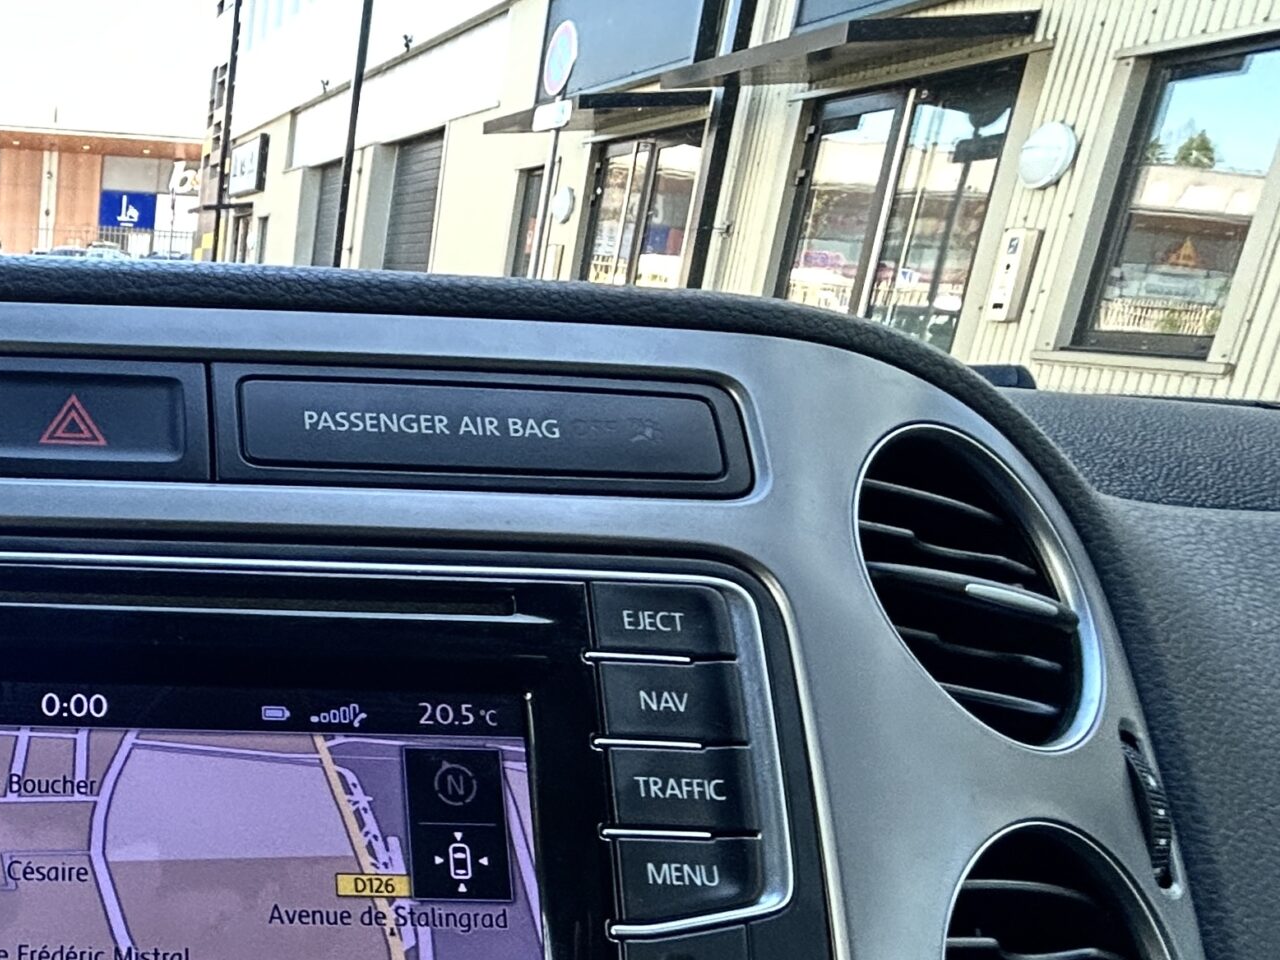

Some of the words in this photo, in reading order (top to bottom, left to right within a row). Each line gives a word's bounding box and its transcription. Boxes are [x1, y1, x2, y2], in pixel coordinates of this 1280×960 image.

[304, 411, 449, 435] PASSENGER
[459, 415, 500, 437] AIR
[508, 417, 561, 438] BAG
[622, 610, 684, 632] EJECT
[41, 693, 109, 718] 0:00
[639, 690, 688, 712] NAV
[418, 702, 475, 726] 20.5
[9, 773, 97, 796] Boucher
[634, 777, 727, 800] TRAFFIC
[7, 860, 89, 882] Césaire
[647, 863, 720, 886] MENU
[354, 877, 395, 894] D126
[268, 904, 352, 927] Avenue
[359, 904, 387, 927] de
[394, 905, 508, 934] Stalingrad
